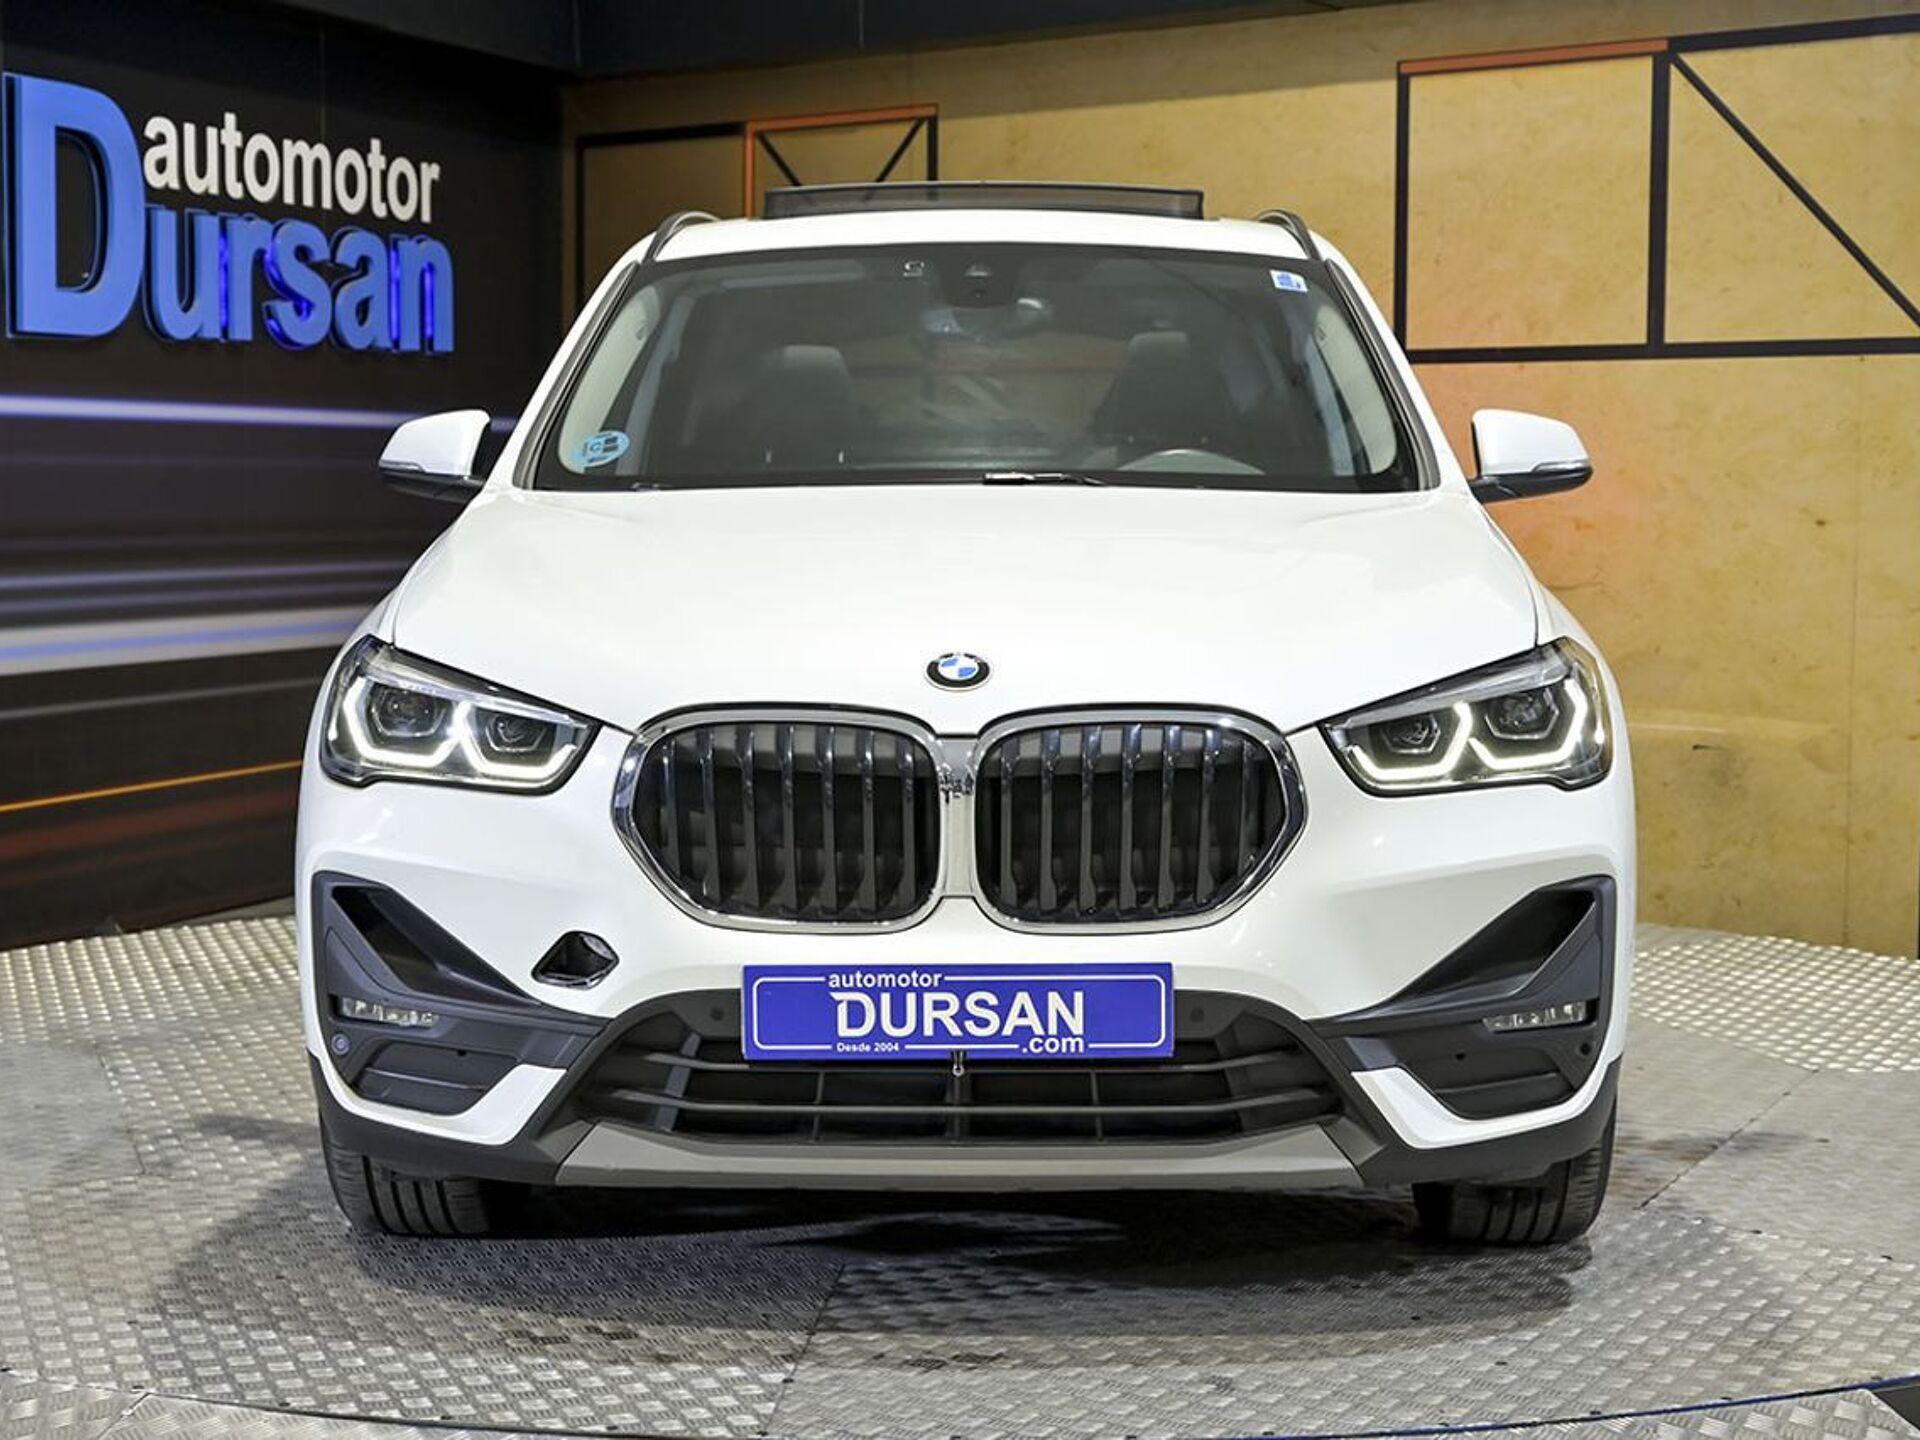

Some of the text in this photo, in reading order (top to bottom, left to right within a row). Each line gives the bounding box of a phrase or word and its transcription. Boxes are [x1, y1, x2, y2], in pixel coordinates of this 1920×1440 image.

[143, 111, 441, 223] automotor
[3, 72, 456, 353] Dursan
[828, 970, 943, 988] automotor
[828, 991, 1085, 1037] DURSAN
[1021, 1036, 1085, 1054] .com
